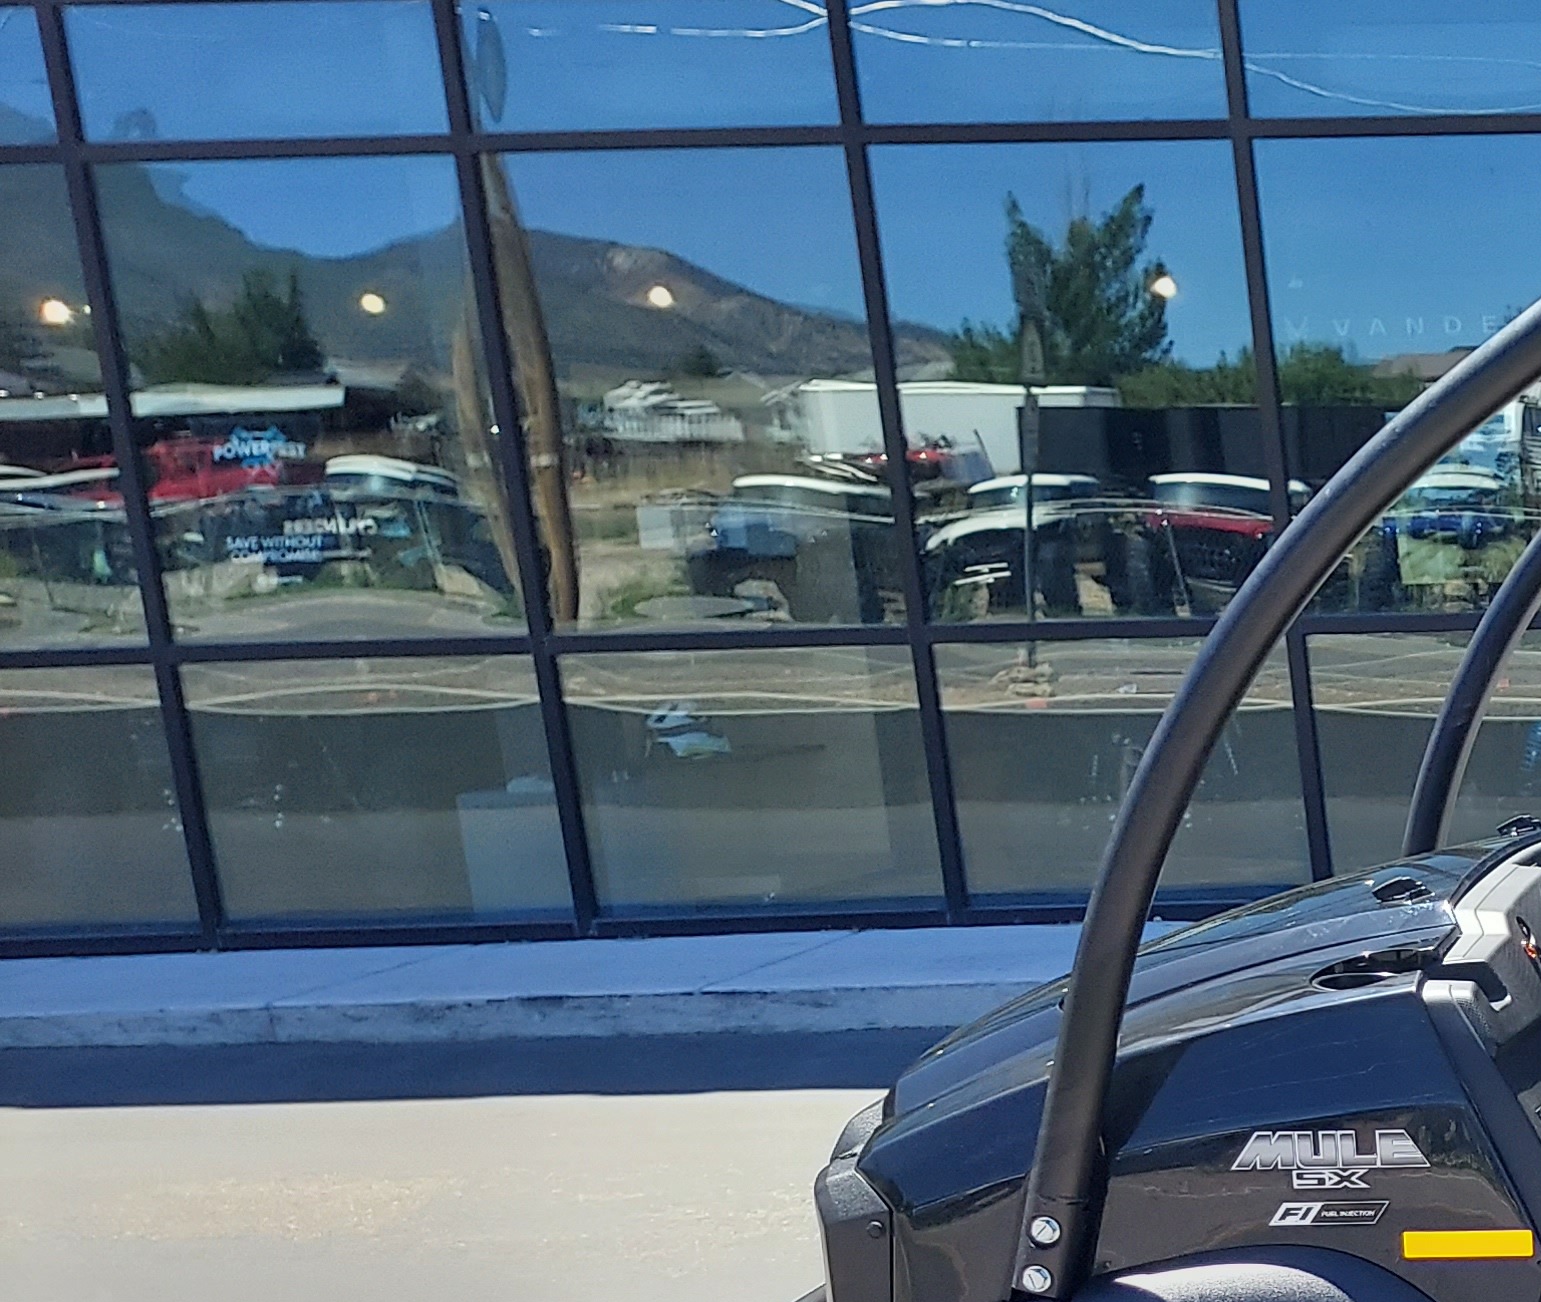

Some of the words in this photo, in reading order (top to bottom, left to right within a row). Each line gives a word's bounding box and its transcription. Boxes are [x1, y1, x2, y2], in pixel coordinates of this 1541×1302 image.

[261, 534, 323, 548] WITHOUT
[1230, 1129, 1431, 1171] MULE
[1292, 1168, 1371, 1190] SX
[1277, 1205, 1317, 1223] FI
[1320, 1210, 1339, 1218] FUEL
[1339, 1209, 1376, 1217] INJECTION
